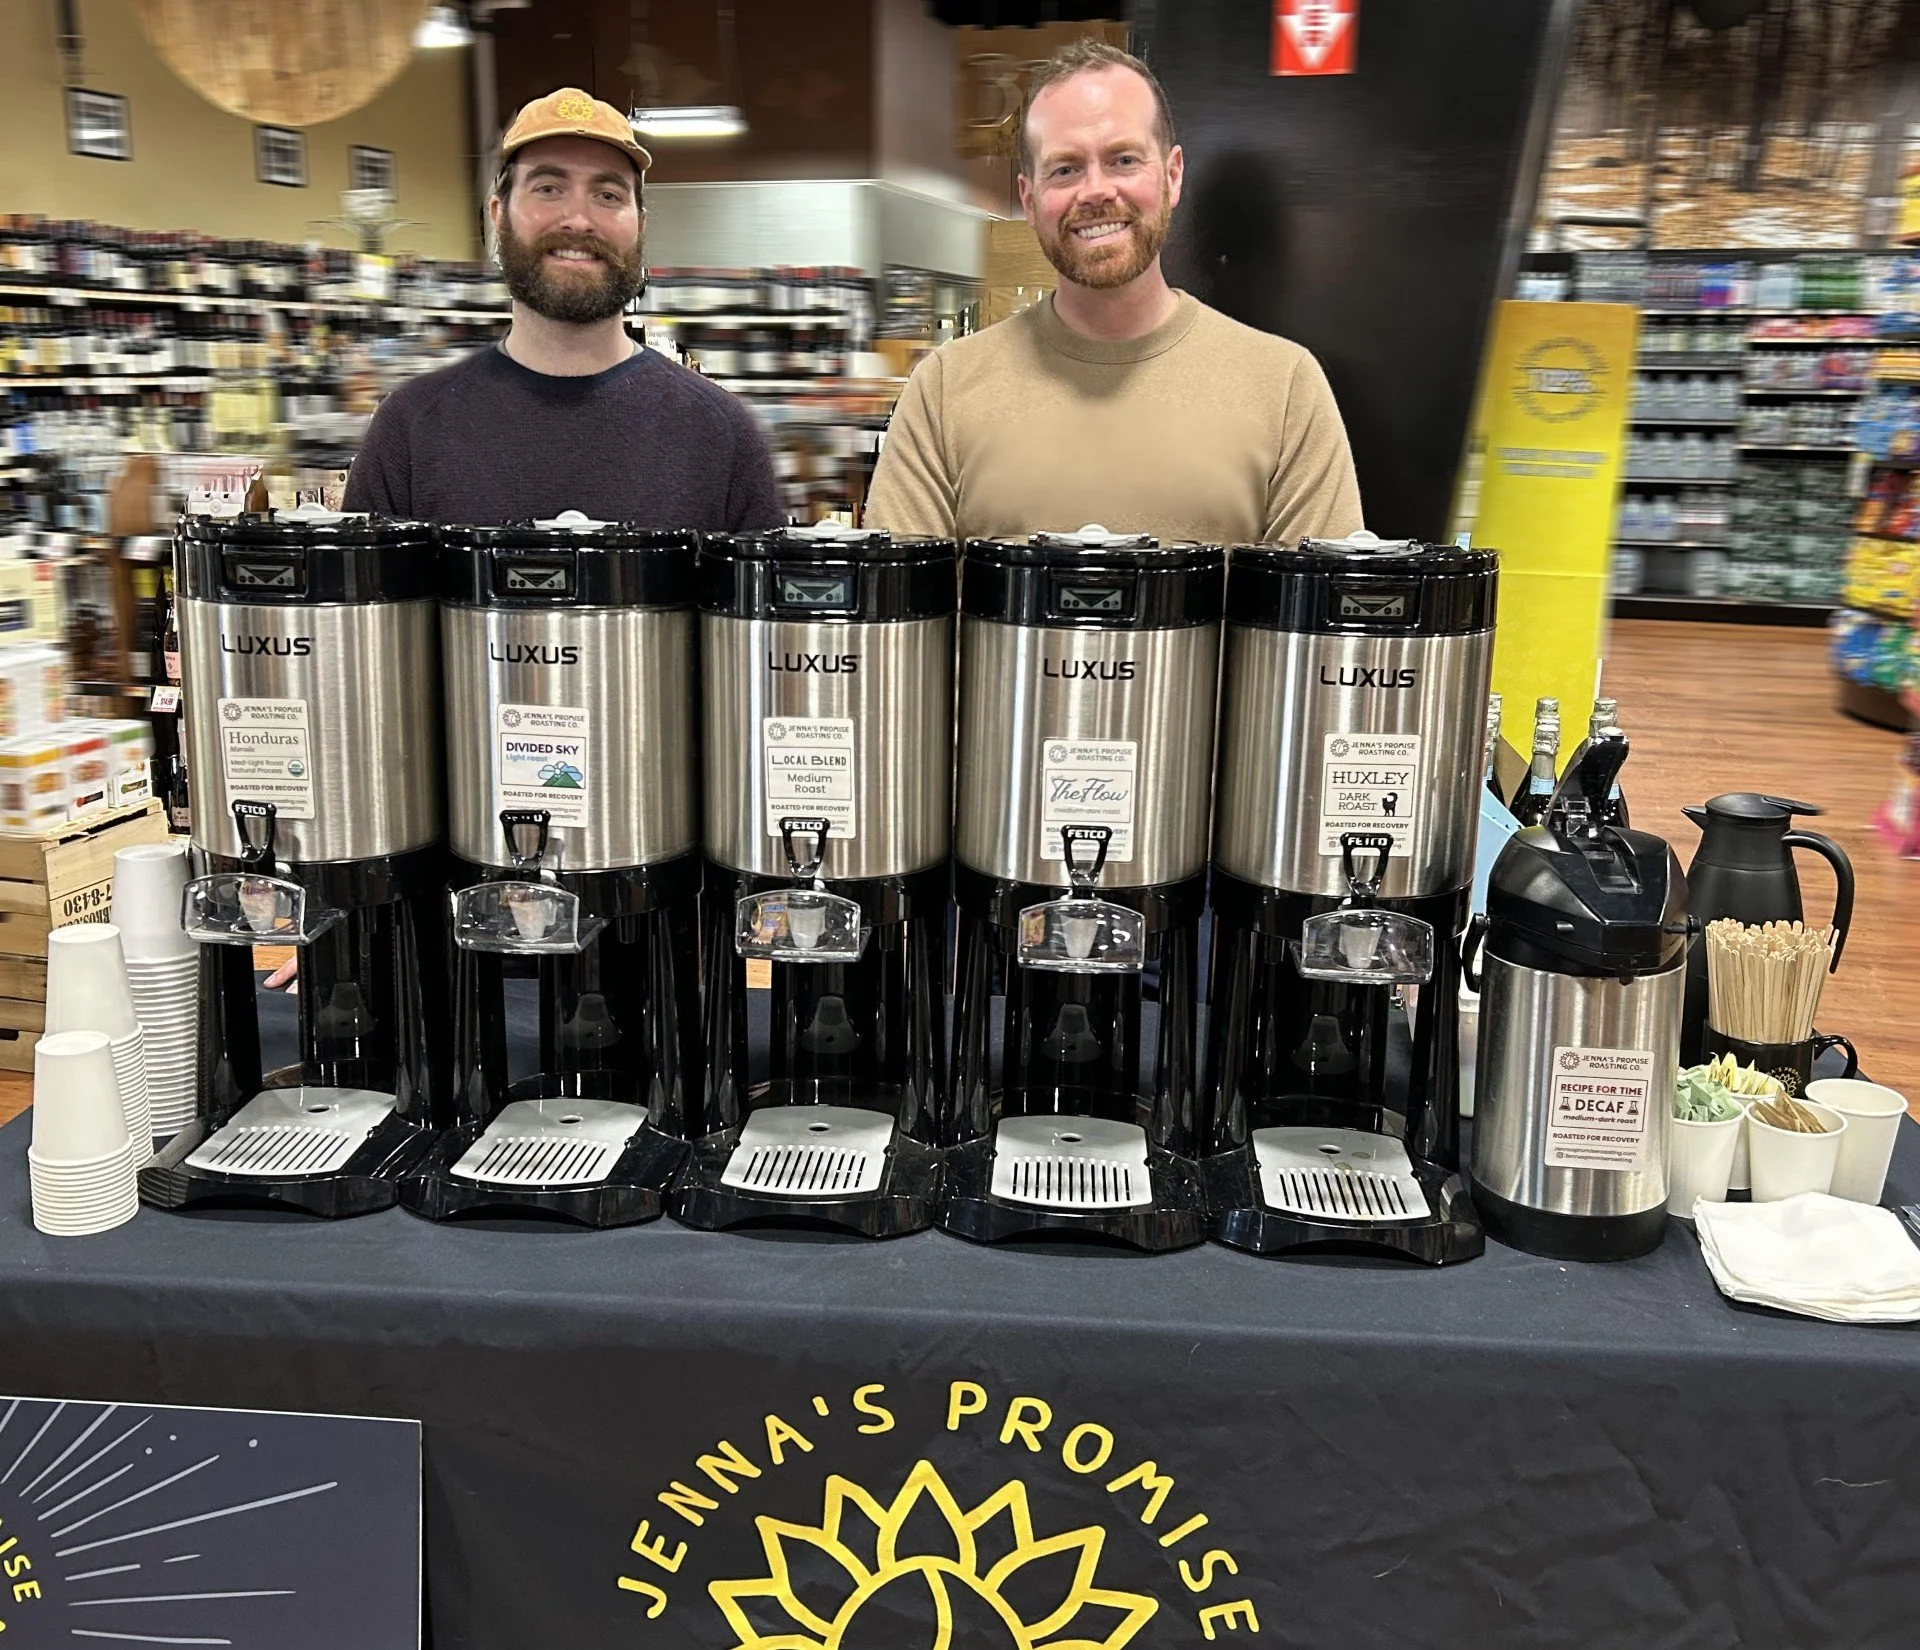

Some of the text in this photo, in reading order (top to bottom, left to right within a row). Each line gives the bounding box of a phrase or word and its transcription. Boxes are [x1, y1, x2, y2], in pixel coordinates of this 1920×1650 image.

[221, 634, 311, 656] LUXUS
[490, 642, 578, 665] LUXUS
[768, 651, 858, 673] LUXUS
[1043, 658, 1135, 680] LUXUS
[1320, 665, 1415, 688] LUXUS
[243, 705, 303, 714] JENNA'S PROMISE
[251, 712, 286, 720] ROASTING
[523, 713, 585, 722] JENNA'S PROMISE
[530, 720, 566, 728] ROASTING
[788, 725, 850, 734] JENNA'S PROMISE
[229, 731, 299, 746] Honduras
[796, 732, 832, 740] ROASTING
[506, 742, 579, 755] DIVIDED SKY
[1384, 742, 1415, 750] PROMISE
[1101, 748, 1133, 756] PROMISE
[1358, 748, 1395, 756] ROASTING
[506, 754, 548, 763] Light roast
[772, 754, 847, 767] LOCAL BLEND
[1076, 754, 1113, 762] ROASTING
[787, 773, 832, 784] Medium
[1332, 771, 1409, 786] HUXLEY
[794, 784, 826, 794] Roast
[503, 790, 534, 798] ROASTED
[549, 792, 583, 801] RECOVERY
[1339, 792, 1371, 801] DARK
[234, 803, 267, 815] FETCO
[816, 805, 850, 813] RECOVERY
[1339, 801, 1378, 811] ROAST
[784, 821, 824, 831] FETCO
[1372, 822, 1409, 830] RECOVERY
[1067, 829, 1107, 839] FETCO
[1582, 1055, 1649, 1065] JENNA'S PROMISE
[1589, 1062, 1628, 1071] ROASTING
[1560, 1083, 1643, 1096] RECIPE FOR TIME
[1575, 1099, 1624, 1113] DECAF
[1563, 1114, 1637, 1125] medium-dark roast
[1553, 1132, 1585, 1140] ROASTED
[1602, 1135, 1640, 1144] RECOVERY
[618, 1381, 1259, 1640] JENNA'S PROMISE
[0, 1537, 42, 1602] ISE
